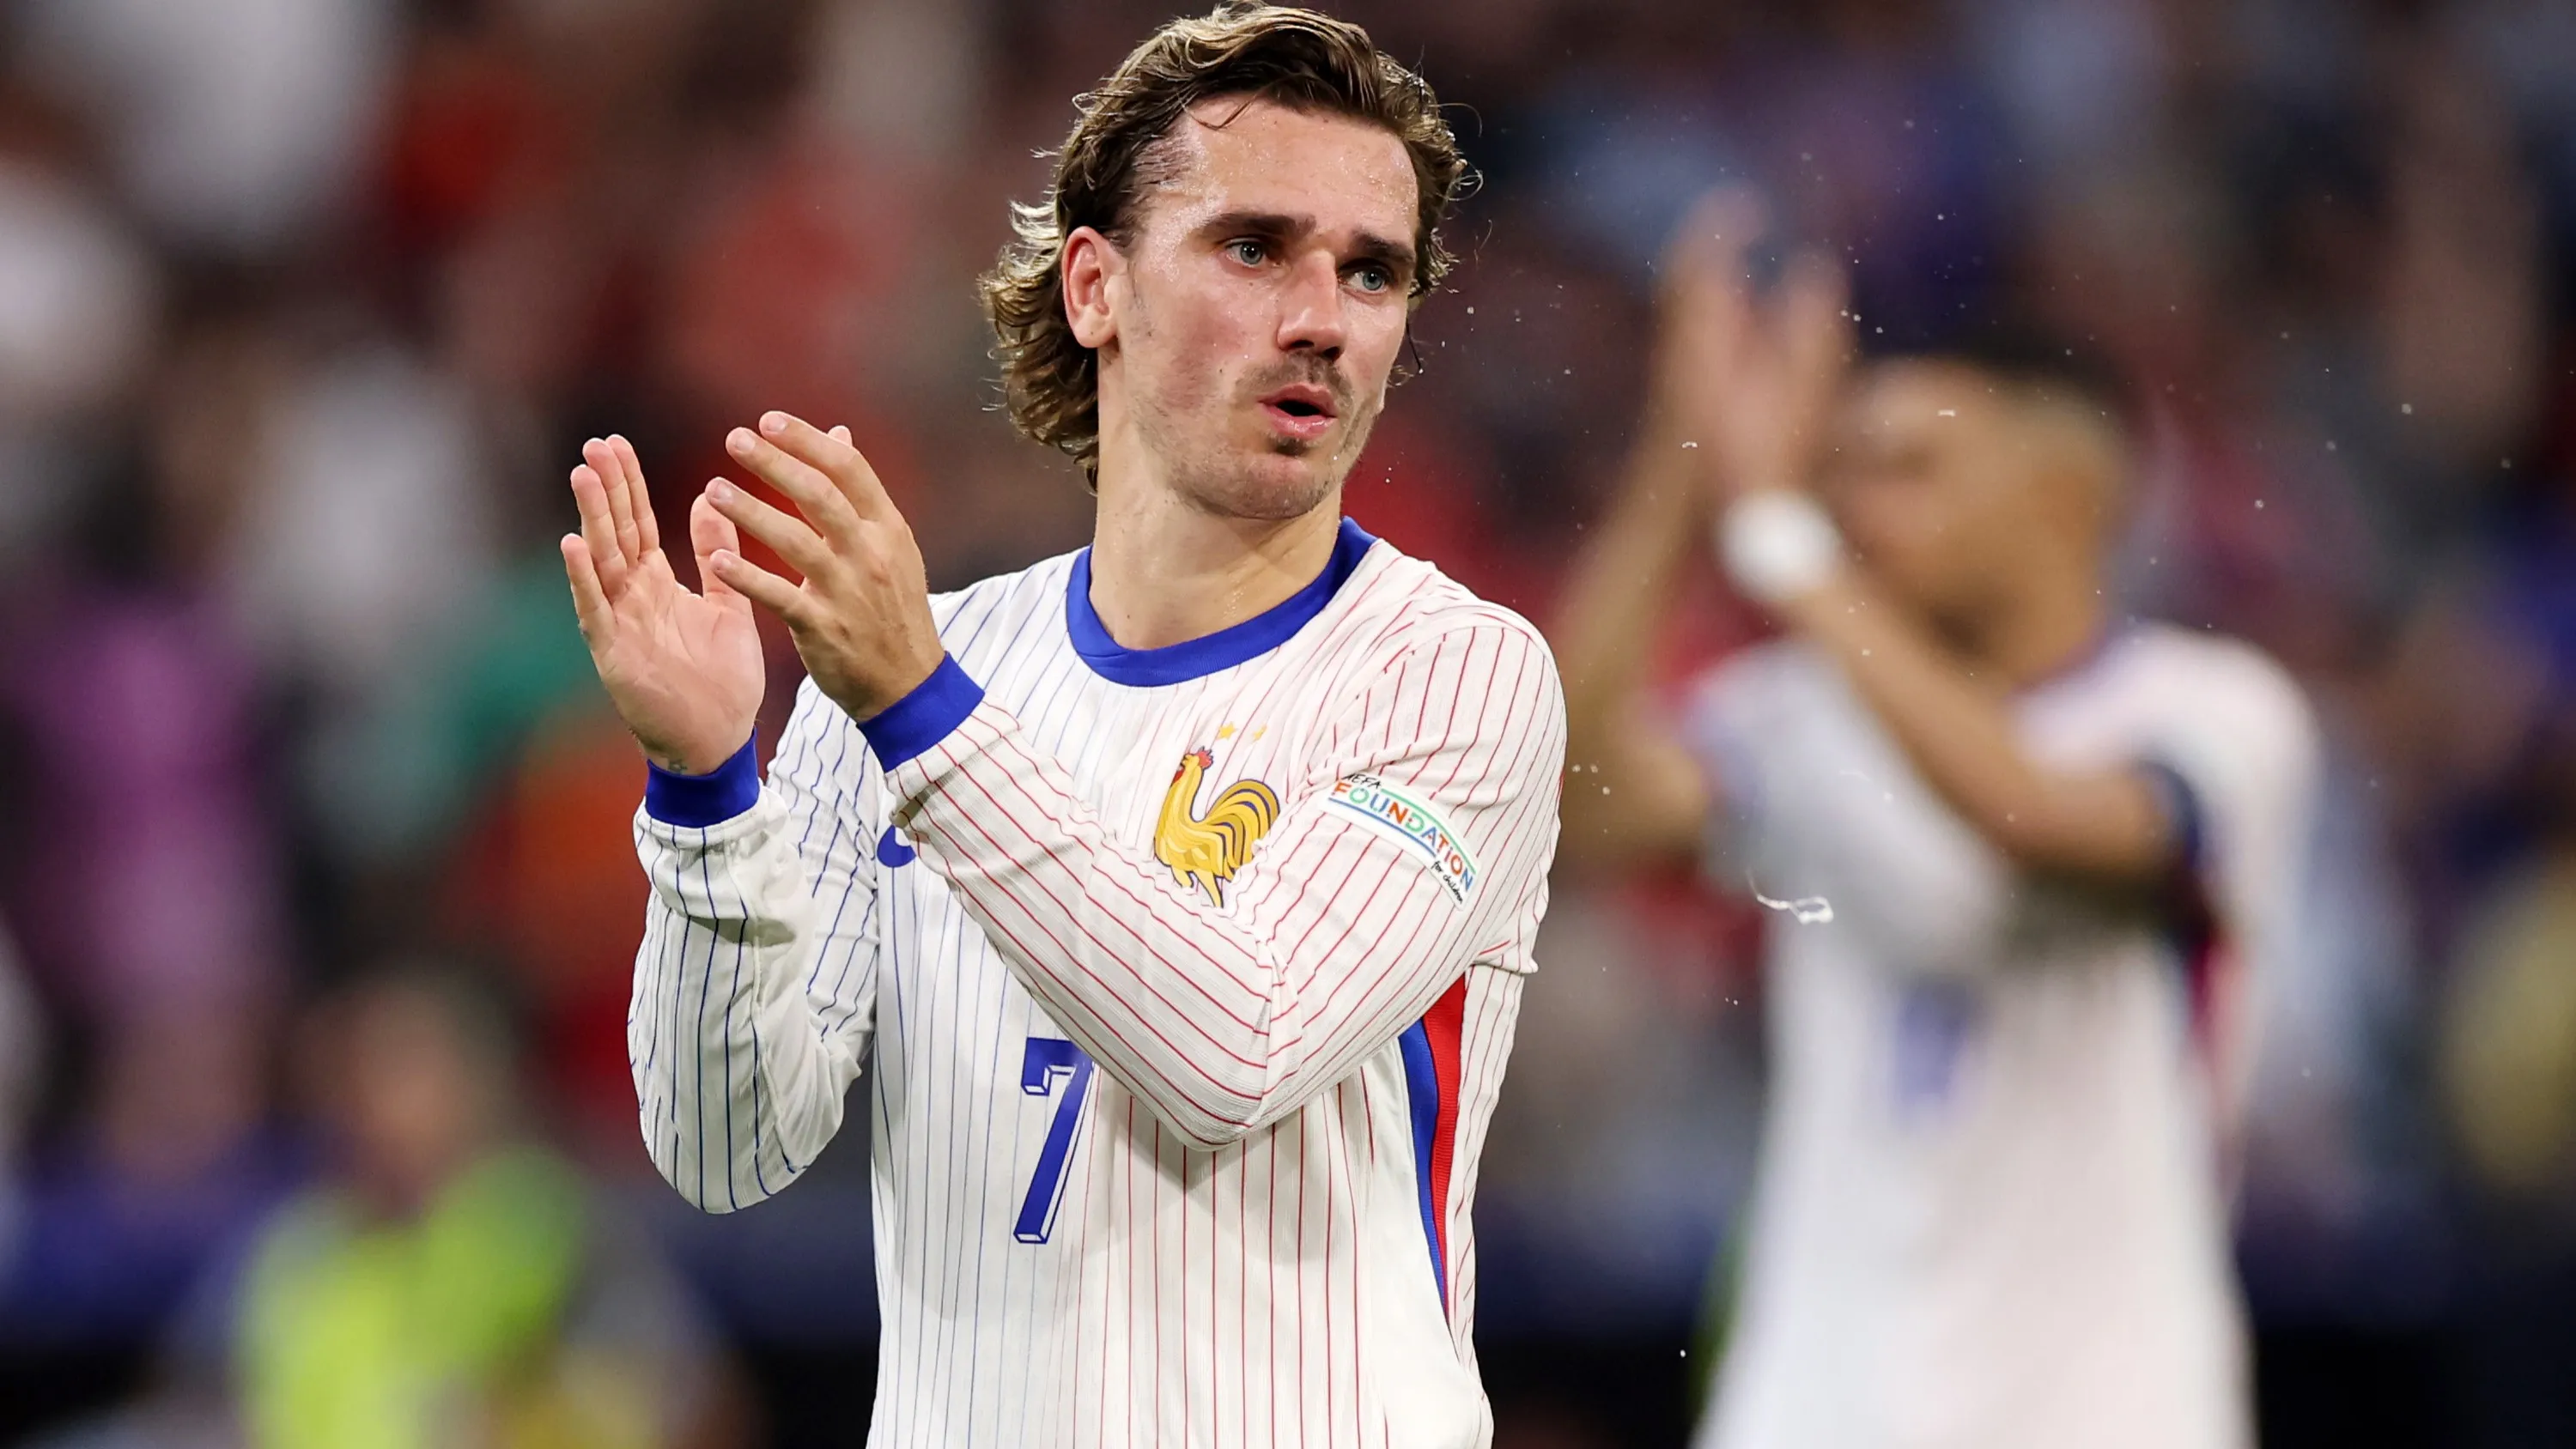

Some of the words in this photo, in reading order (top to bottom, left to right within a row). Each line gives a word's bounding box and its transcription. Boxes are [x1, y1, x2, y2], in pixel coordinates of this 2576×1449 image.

[1332, 782, 1473, 892] FOUNDATION
[1431, 861, 1443, 872] for
[1013, 1037, 1095, 1244] 7
